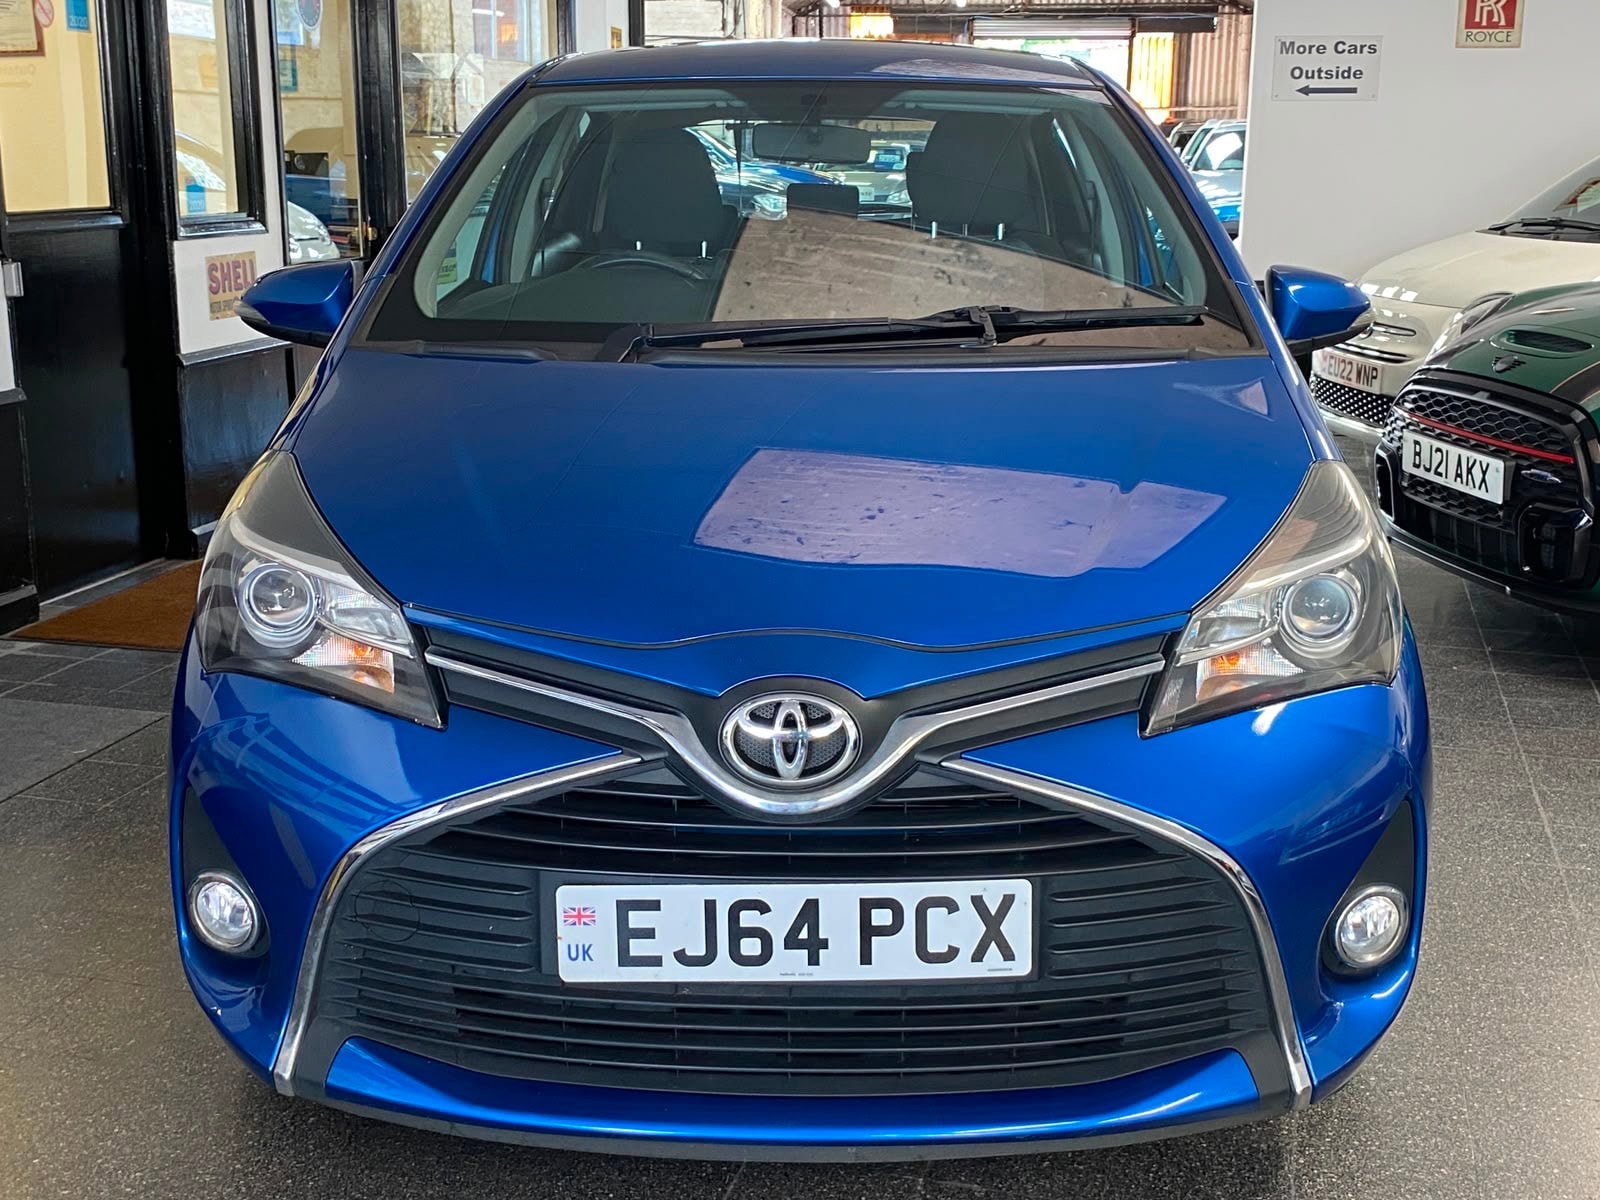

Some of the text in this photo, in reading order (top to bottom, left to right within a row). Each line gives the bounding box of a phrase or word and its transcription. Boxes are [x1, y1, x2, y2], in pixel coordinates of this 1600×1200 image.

[70, 16, 88, 27] 2020
[1465, 30, 1513, 43] ROYCE
[1279, 40, 1378, 55] More Cars
[1290, 66, 1364, 80] Outside
[1327, 355, 1354, 382] EU22
[1355, 362, 1379, 388] WNP
[1412, 439, 1490, 494] BJ21 AKX
[615, 893, 1016, 968] EJ64 PCX
[567, 944, 594, 962] UK
